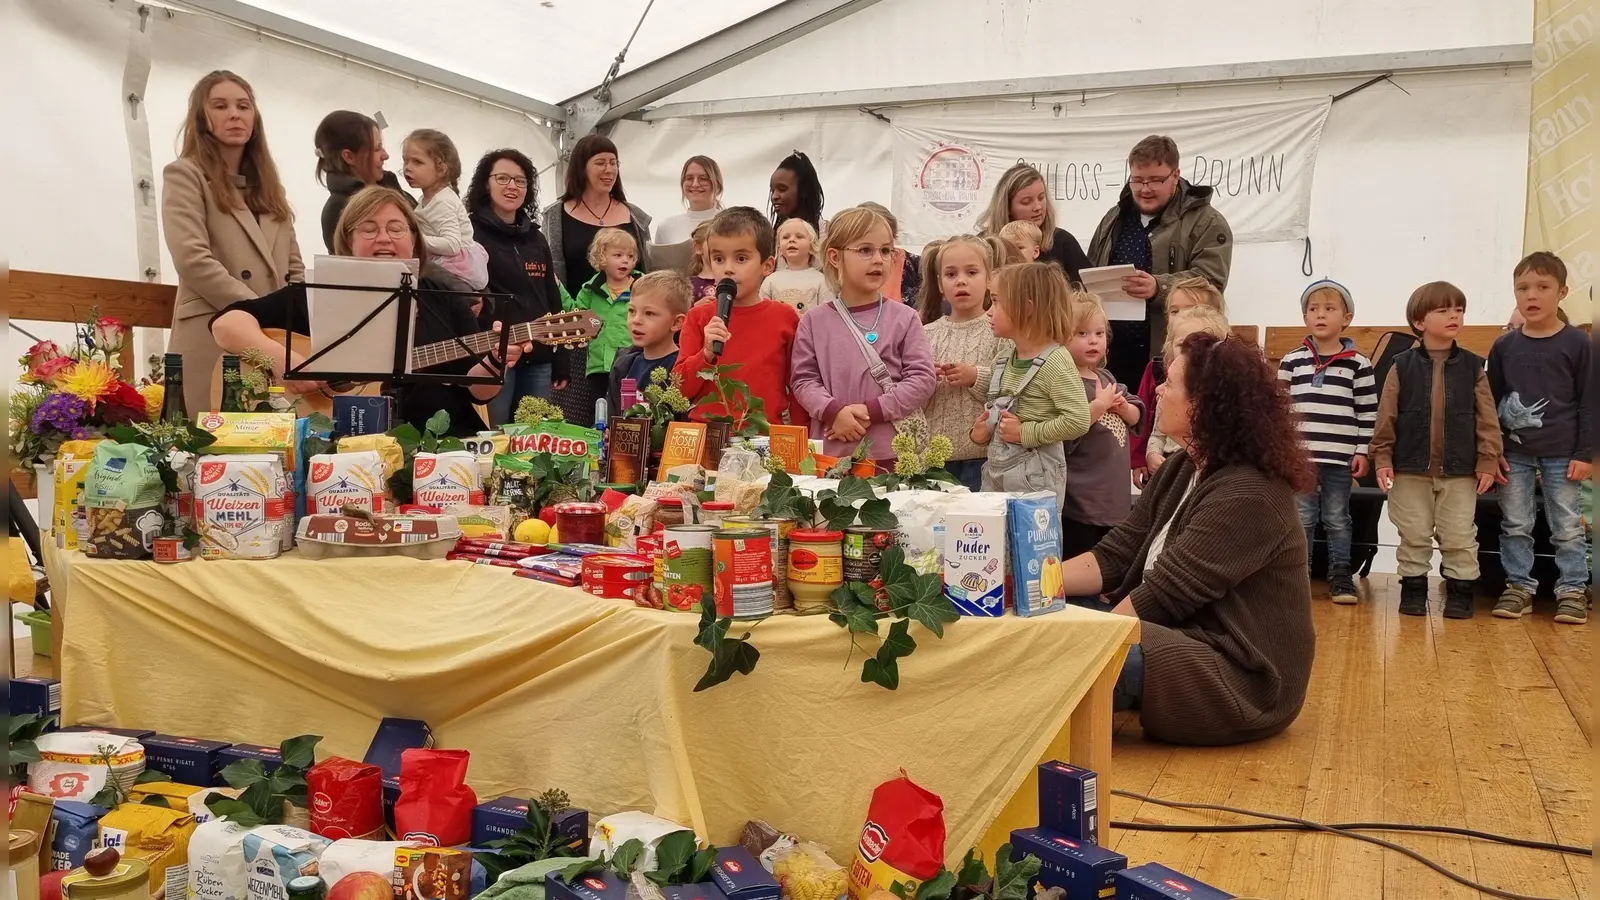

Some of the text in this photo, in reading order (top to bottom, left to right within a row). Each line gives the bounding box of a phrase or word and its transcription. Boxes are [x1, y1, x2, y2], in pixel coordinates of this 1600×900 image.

[1192, 153, 1284, 198] BRUNN
[1544, 160, 1592, 220] Ho
[615, 431, 640, 443] MOSER
[671, 435, 698, 447] MOSER
[511, 433, 588, 456] HARIBO
[614, 442, 639, 454] ROTH
[774, 442, 797, 456] MOSER
[669, 446, 696, 458] ROTH
[320, 495, 369, 507] Weizen
[420, 490, 466, 502] Weizen
[207, 497, 260, 510] Weizen
[216, 511, 252, 521] MEHL
[1027, 527, 1058, 543] PUDDING
[956, 540, 990, 553] Puder
[117, 756, 134, 765] XXL
[157, 756, 173, 764] PENNE
[176, 758, 195, 767] RIGATE
[103, 834, 121, 848] ja!
[1029, 834, 1061, 848] FUSILLI
[1022, 851, 1076, 879] FLLI N°98
[194, 870, 223, 887] Rüben
[1136, 875, 1172, 892] FUSILLI
[195, 883, 224, 896] Zucker
